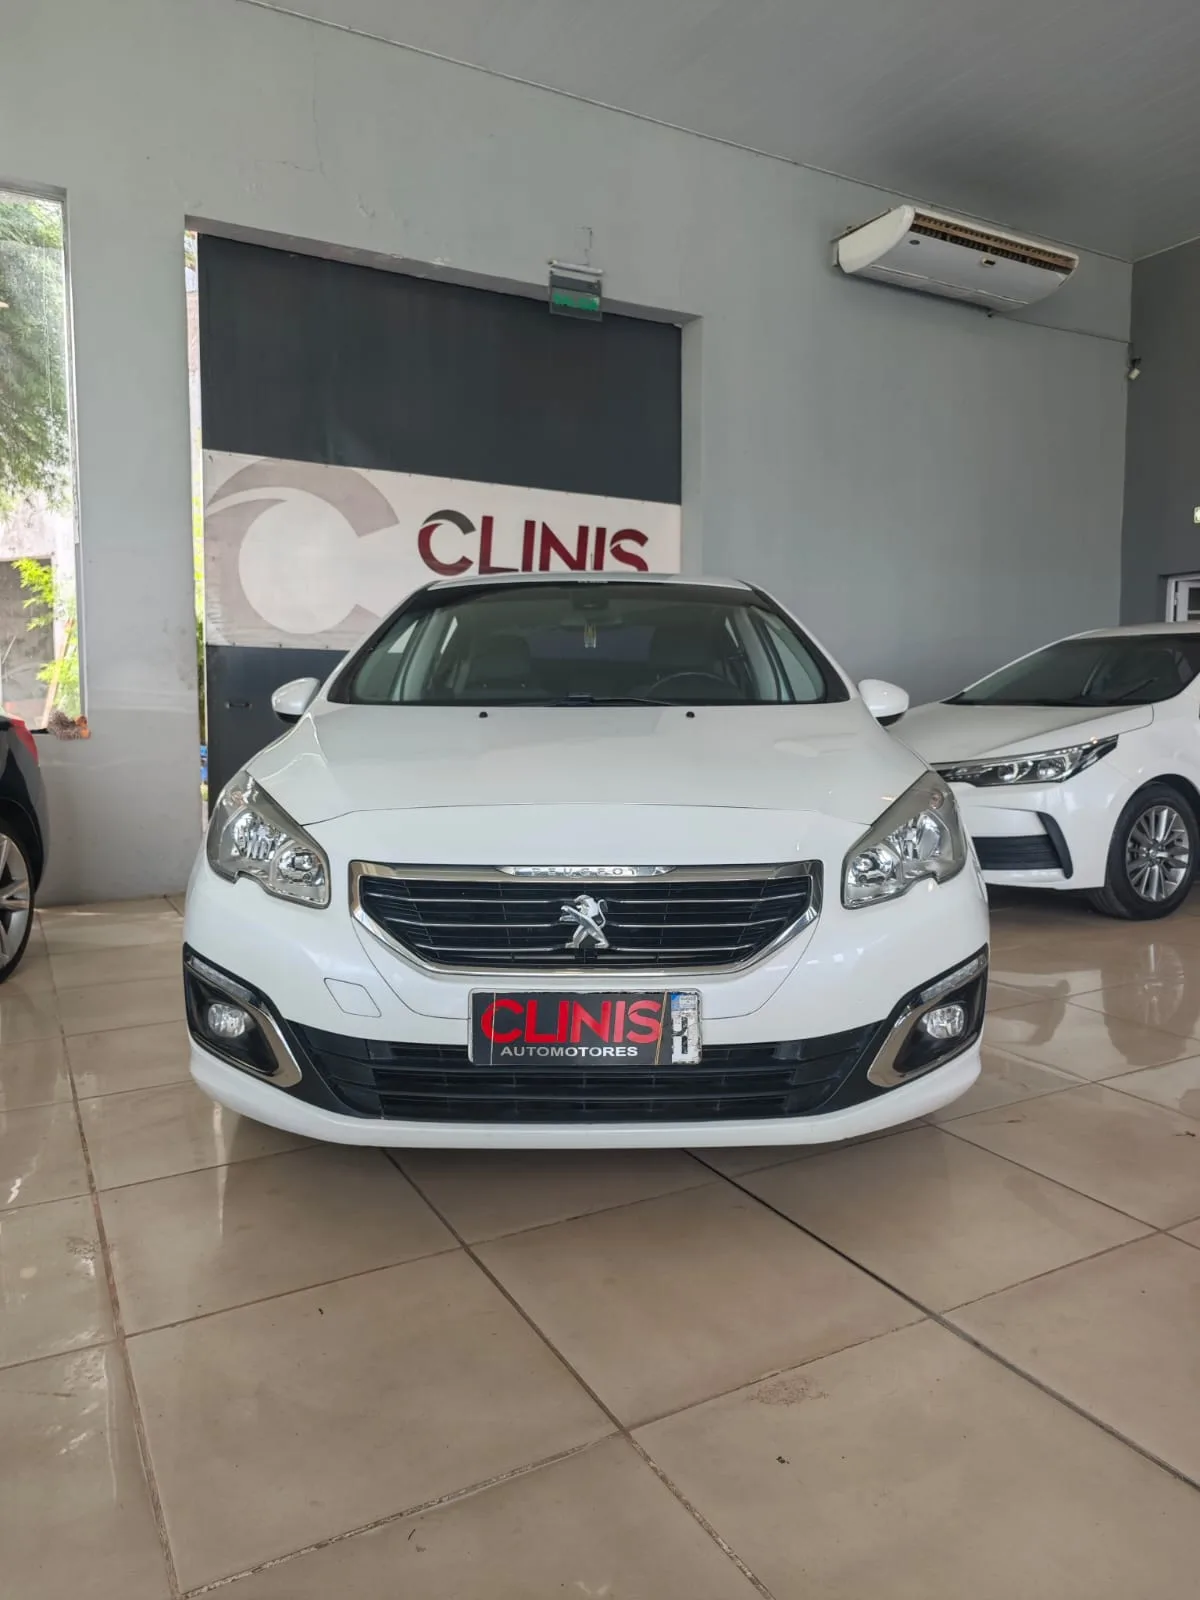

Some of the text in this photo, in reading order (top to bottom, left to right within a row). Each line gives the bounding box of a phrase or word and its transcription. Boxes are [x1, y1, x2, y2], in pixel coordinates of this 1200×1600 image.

[418, 509, 649, 577] CLINIS
[480, 998, 662, 1044] CLINIS
[500, 1046, 638, 1057] AUTOMOTORES
